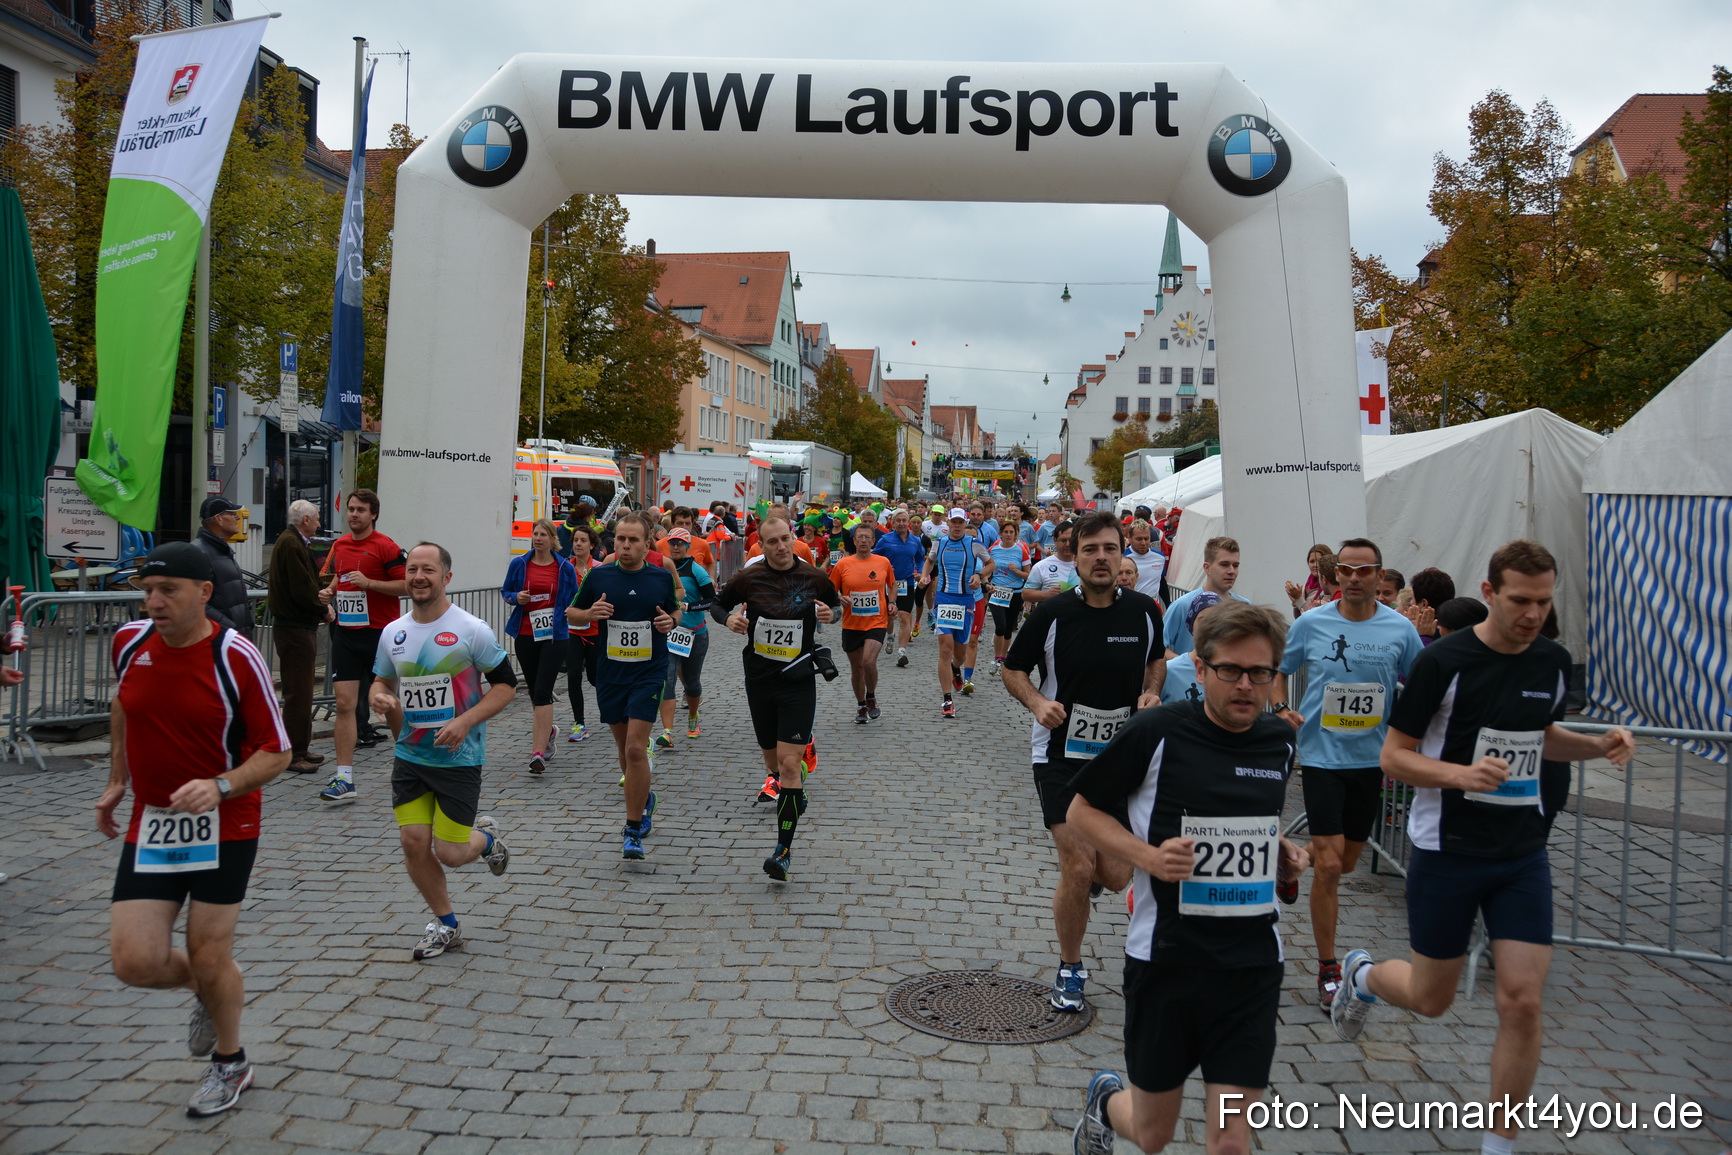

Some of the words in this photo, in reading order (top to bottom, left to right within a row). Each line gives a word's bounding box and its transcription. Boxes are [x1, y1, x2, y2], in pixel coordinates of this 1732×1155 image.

[557, 69, 775, 132] BMW
[795, 74, 1179, 152] Laufsport
[457, 107, 522, 134] BMW
[1215, 115, 1282, 143] BMW
[216, 393, 223, 424] P
[242, 443, 247, 456] 3
[382, 447, 491, 463] www.bmw-laufsport.de
[1245, 460, 1361, 476] www.bmw-laufsport.de
[49, 486, 84, 496] Fußgänge
[61, 497, 94, 505] Lammsbr
[58, 507, 91, 516] Kreuzung
[72, 518, 95, 526] Untere
[61, 527, 105, 537] Kaserngasse
[993, 590, 1011, 600] 3051
[338, 599, 364, 613] 3075
[853, 596, 877, 607] 2136
[940, 609, 963, 621] 2495
[535, 615, 553, 629] 203
[620, 631, 639, 647] 88
[667, 631, 691, 646] 2099
[764, 629, 794, 646] 124
[766, 647, 787, 656] Stefan
[1354, 643, 1376, 652] GYM
[1378, 645, 1391, 653] HIP
[414, 679, 441, 687] Neumarkt
[1326, 686, 1346, 694] PARTL
[404, 686, 447, 709] 2187
[1337, 695, 1373, 715] 143
[411, 711, 445, 722] Benjamin
[1073, 708, 1093, 719] PARTL
[1094, 711, 1122, 720] Neumarkt
[1339, 718, 1365, 727] Stefan
[1480, 734, 1507, 745] PARTL
[1085, 743, 1105, 752] Bern
[1243, 768, 1283, 780] PFLEIDERER
[1498, 784, 1527, 794] ndreas
[147, 815, 212, 845] 2208
[1184, 826, 1221, 837] PARTL
[1223, 827, 1267, 837] Neumarkt
[167, 851, 190, 862] Max
[1193, 841, 1270, 878] 2281
[1208, 887, 1259, 905] Rüdiger
